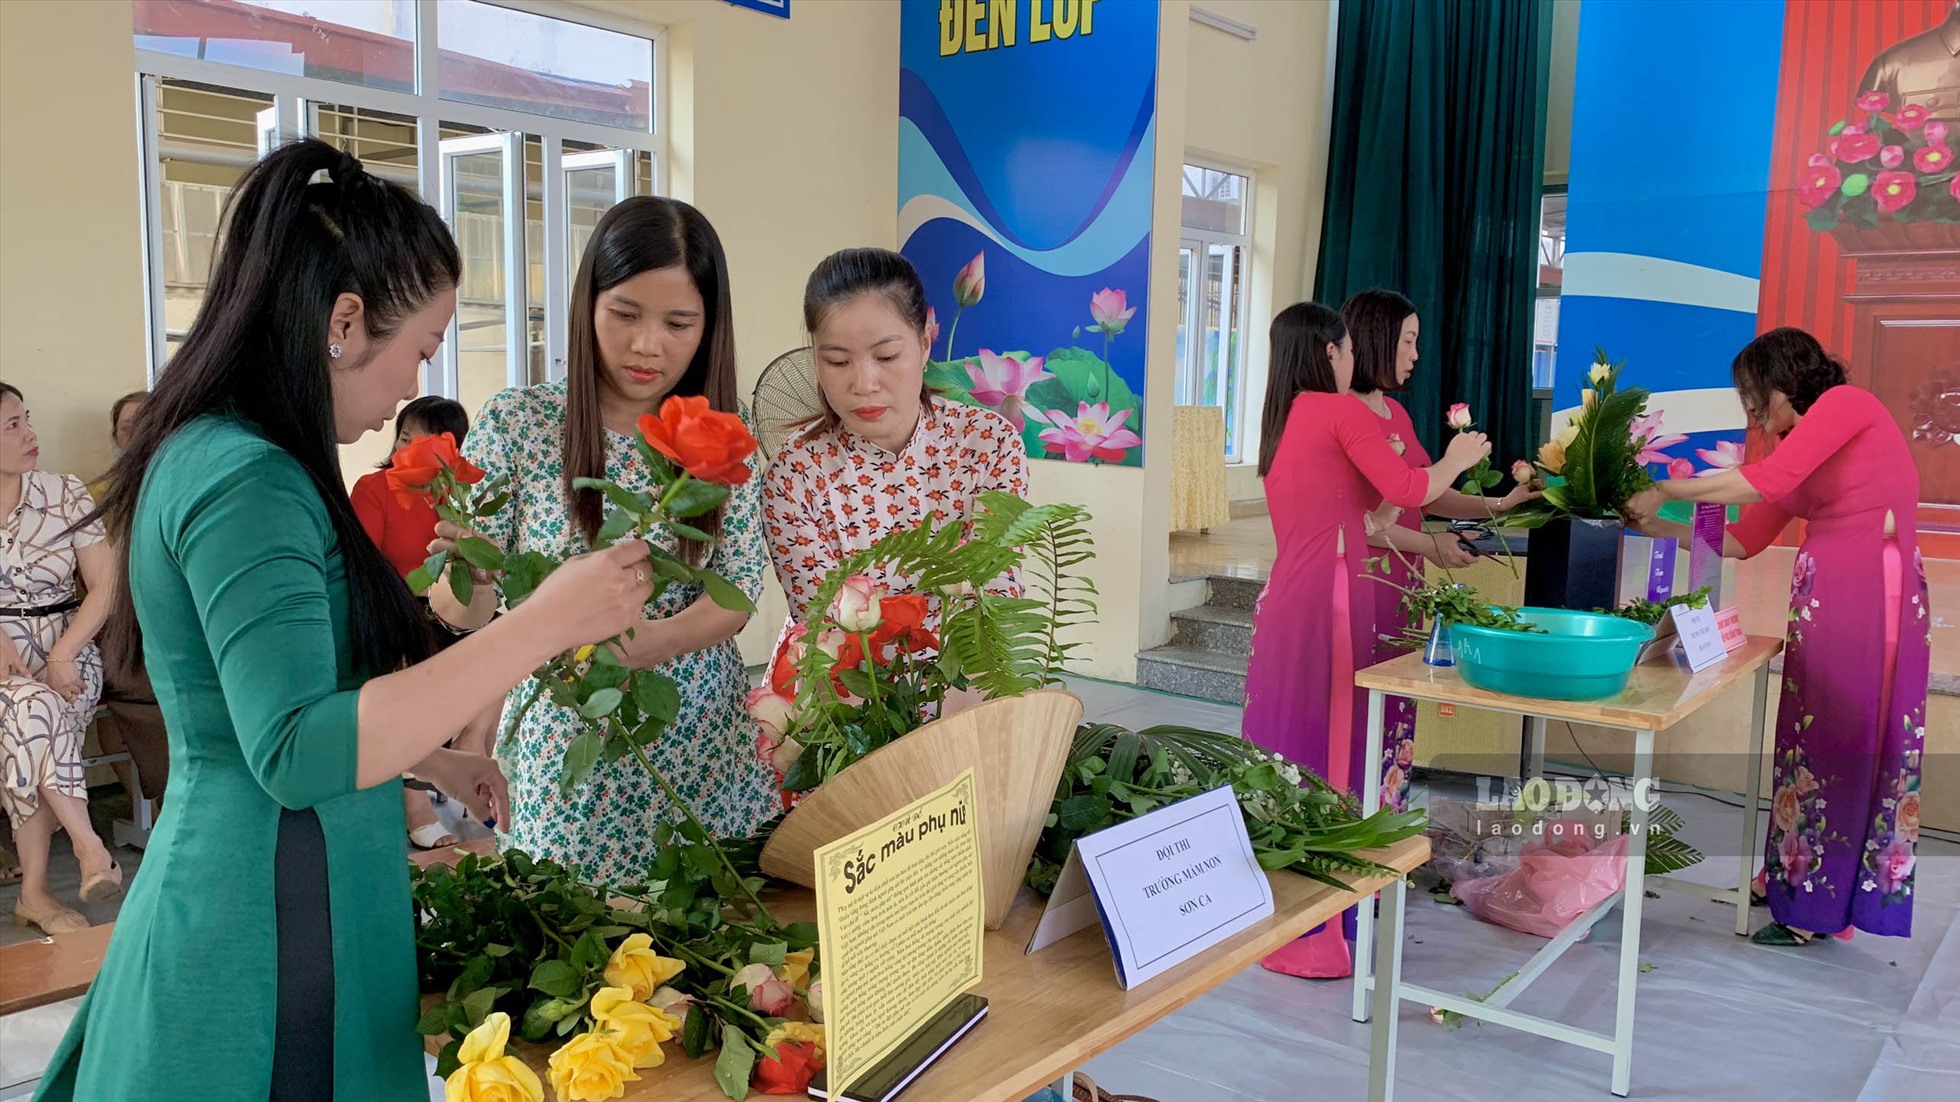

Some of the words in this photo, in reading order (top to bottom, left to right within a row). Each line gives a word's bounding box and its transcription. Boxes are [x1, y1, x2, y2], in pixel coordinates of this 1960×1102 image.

[1173, 838, 1191, 853] THI
[844, 849, 876, 894] Sắc
[881, 829, 914, 862] màu
[919, 814, 946, 840] phụ
[1203, 855, 1221, 872] NON
[1198, 893, 1212, 907] CA
